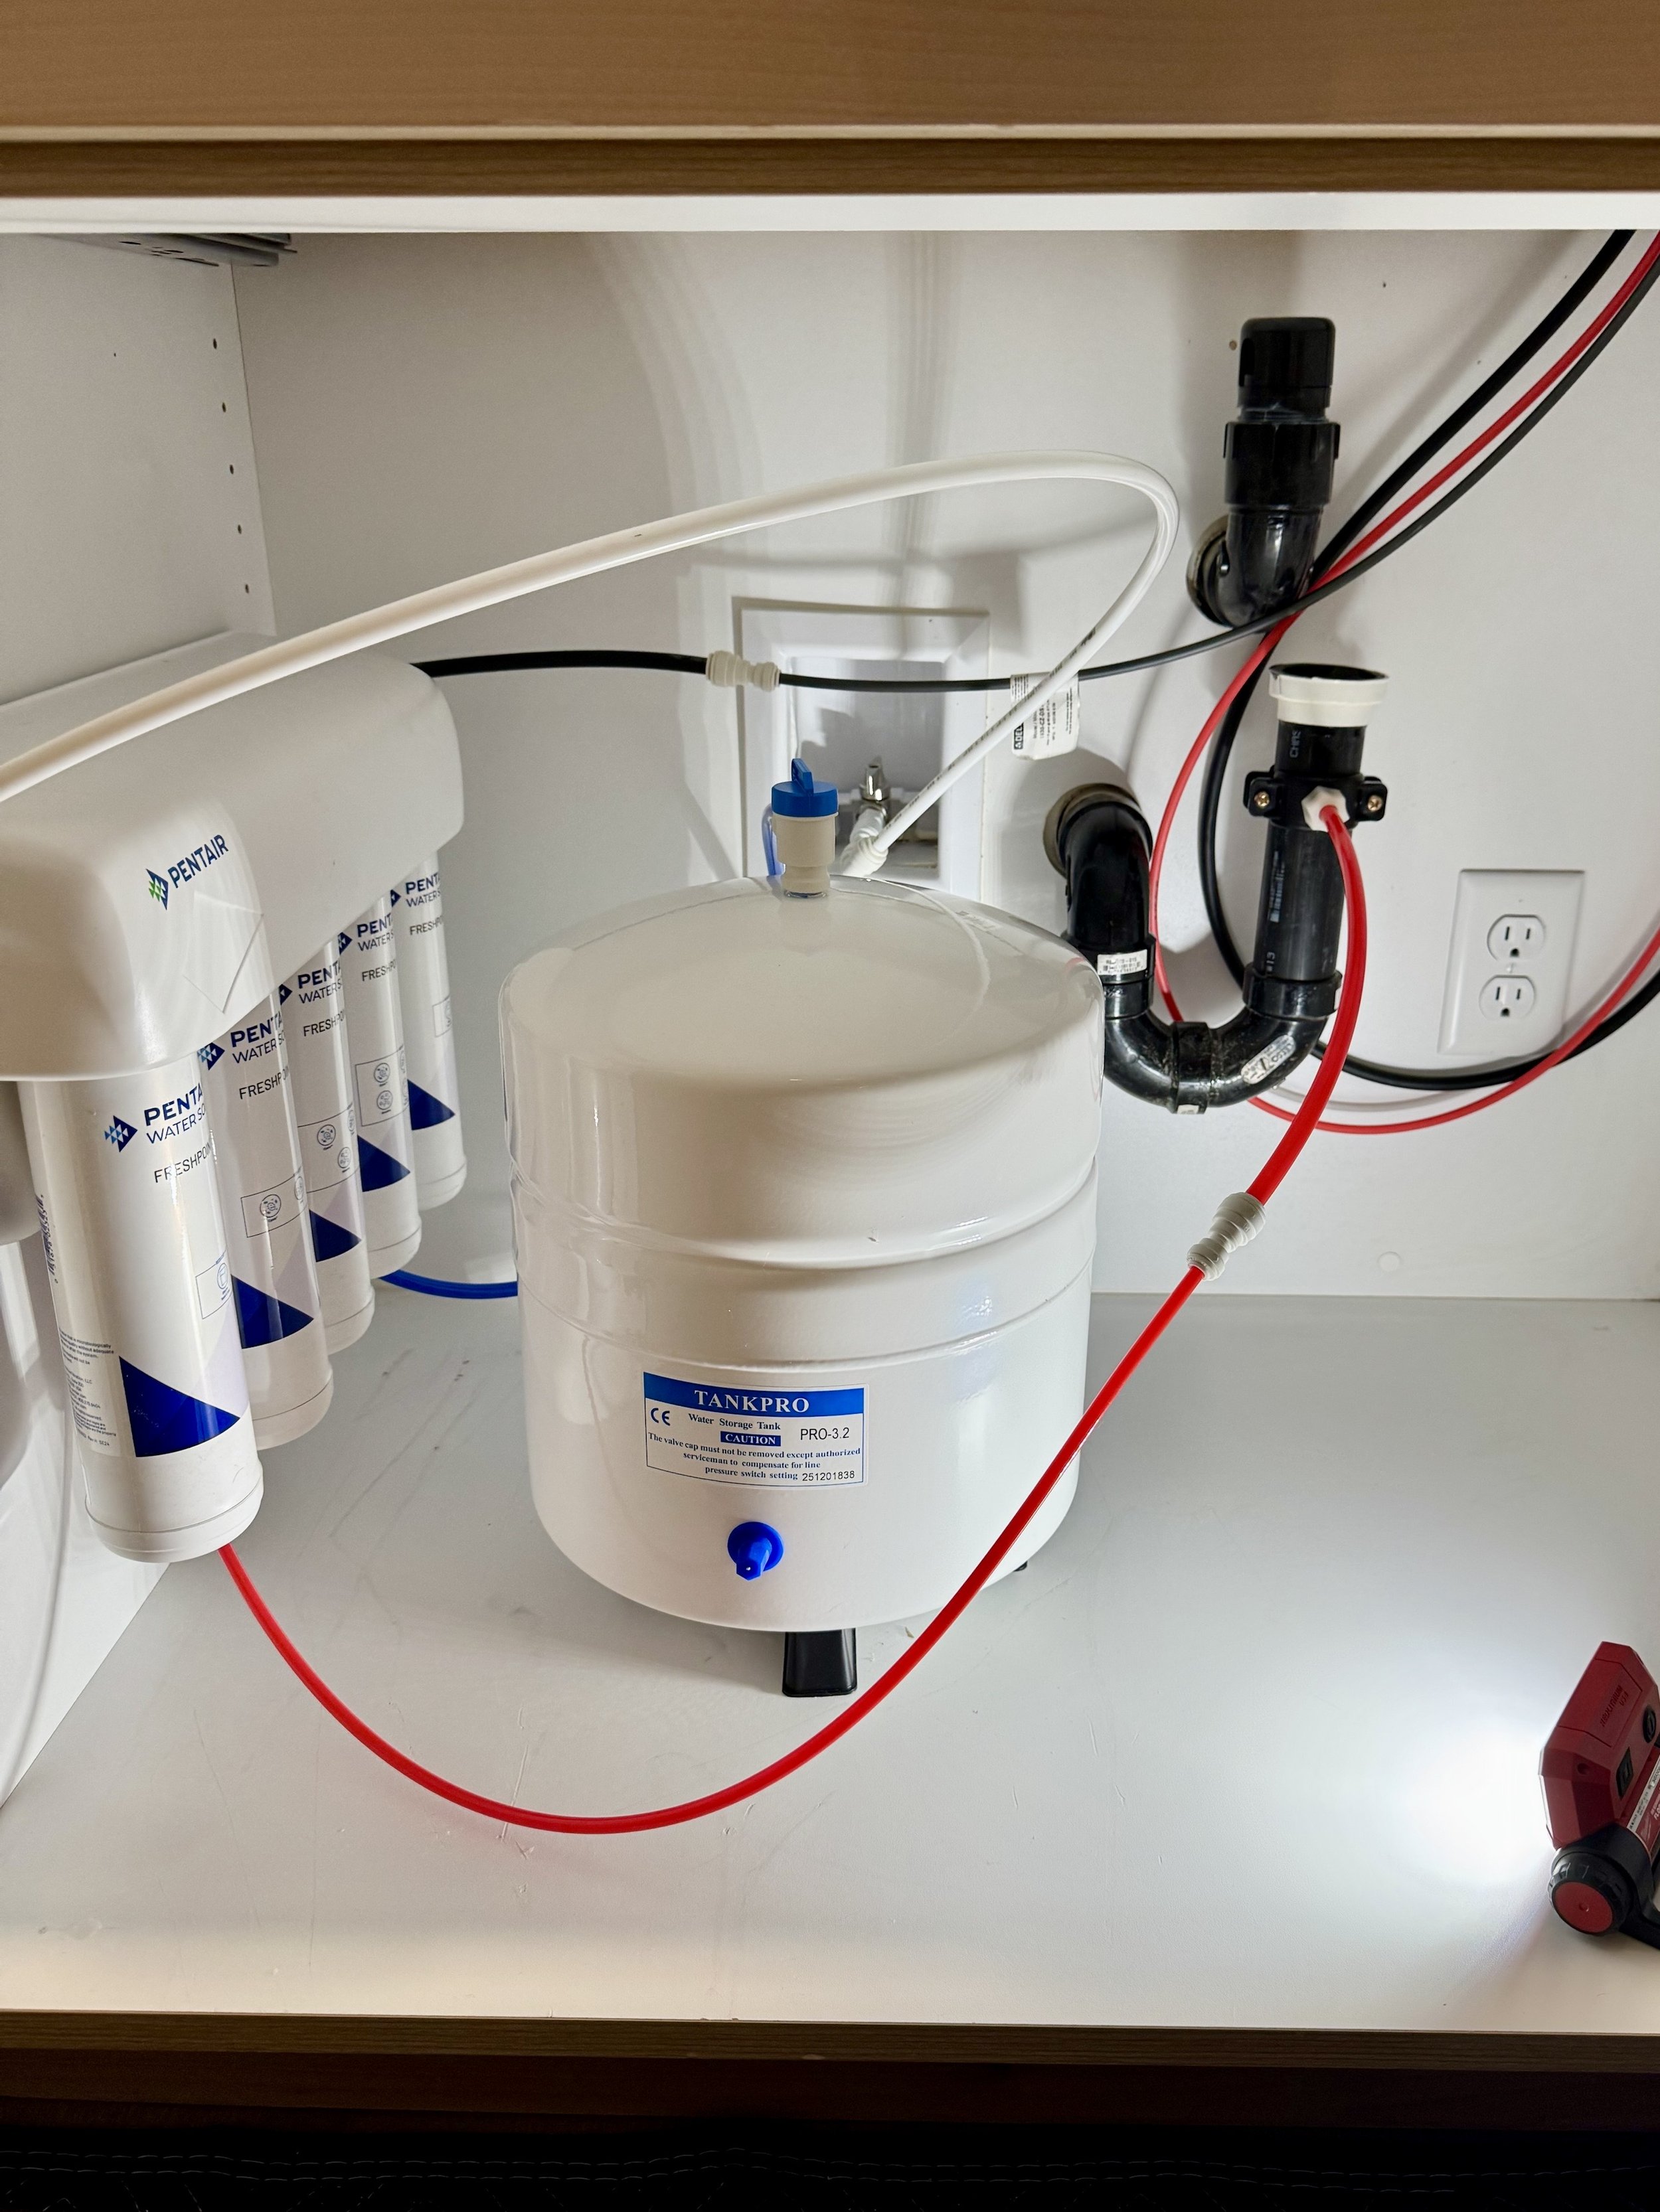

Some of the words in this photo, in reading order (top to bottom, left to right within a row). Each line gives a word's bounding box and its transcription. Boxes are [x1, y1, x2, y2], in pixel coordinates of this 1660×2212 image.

[168, 834, 228, 888] PENTAIR
[299, 983, 337, 1004] WATER
[232, 1038, 277, 1064] WATER
[146, 1114, 197, 1144] WATER
[694, 1390, 809, 1413] TANKPRO
[688, 1413, 714, 1424] Water
[719, 1418, 753, 1430] Storage
[757, 1421, 781, 1430] Tank
[725, 1433, 776, 1445] CAUTION
[800, 1427, 849, 1440] PRO-3.2
[648, 1432, 663, 1443] The
[664, 1438, 683, 1447] valve
[815, 1448, 861, 1457] authorized
[683, 1452, 728, 1464] serviceman
[705, 1467, 738, 1476] pressure
[802, 1470, 855, 1481] 251201838
